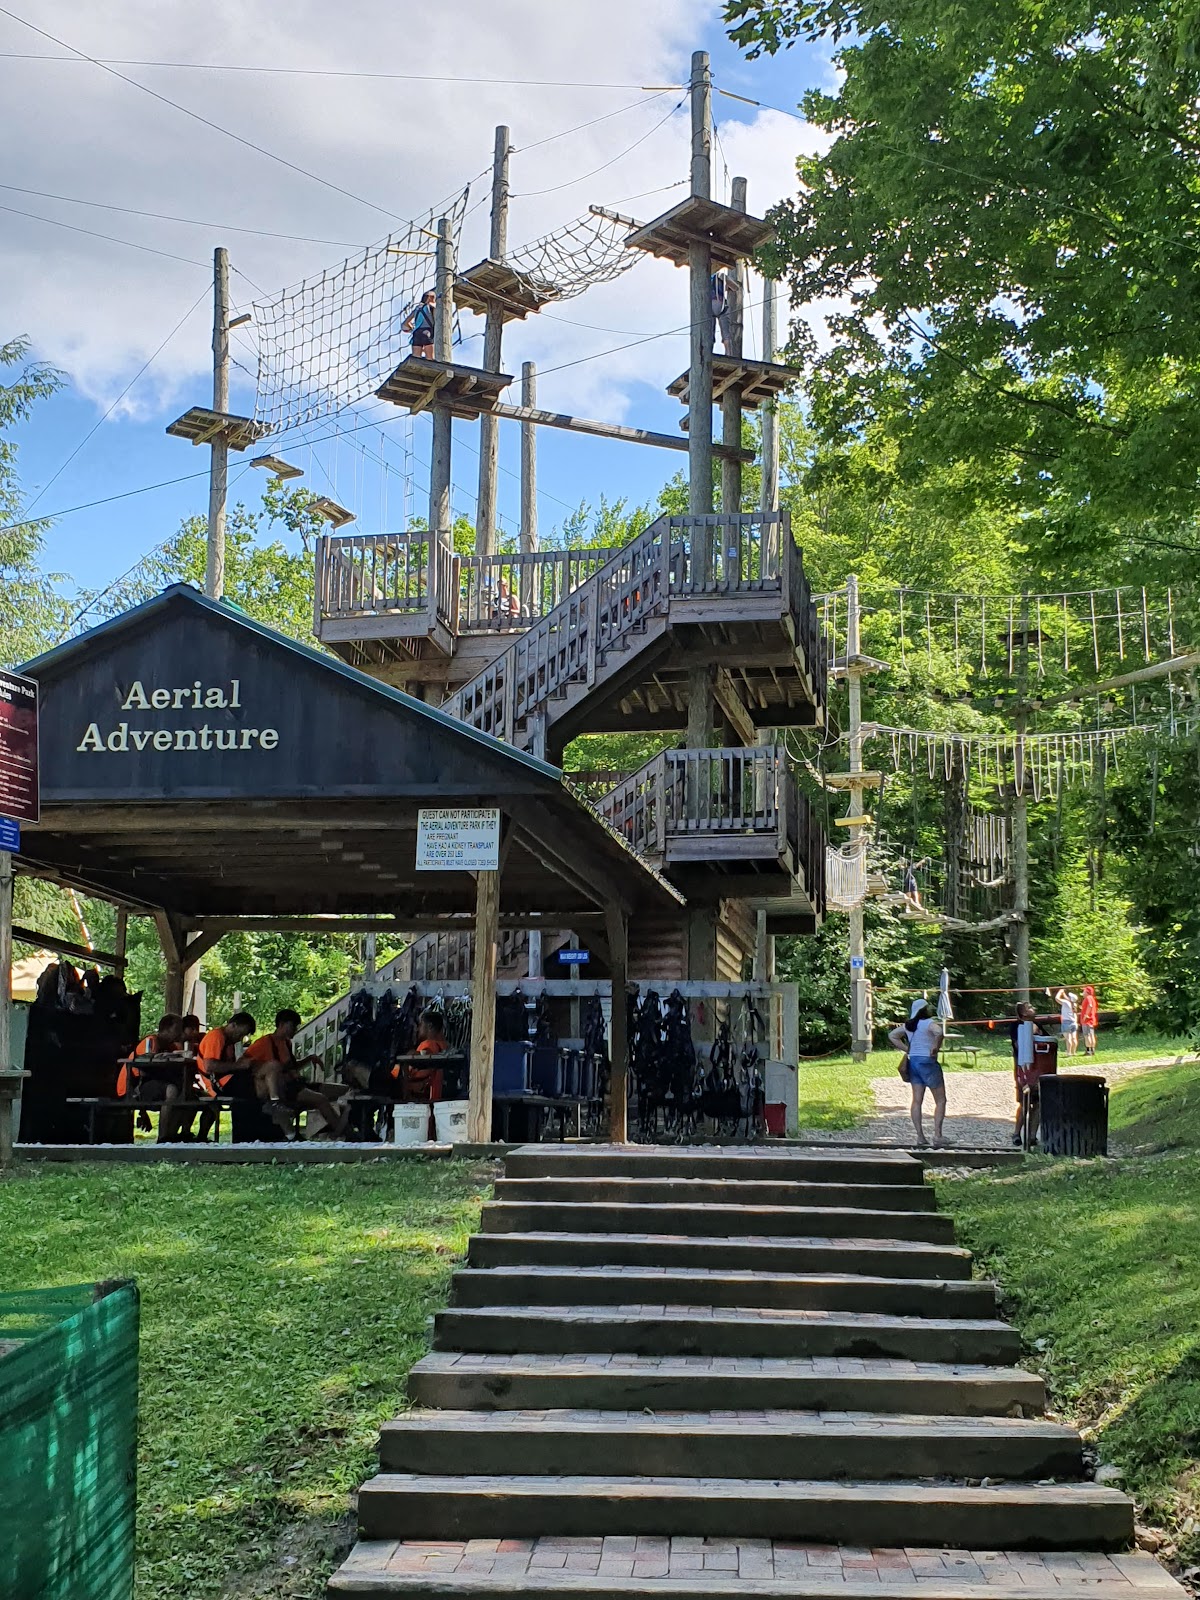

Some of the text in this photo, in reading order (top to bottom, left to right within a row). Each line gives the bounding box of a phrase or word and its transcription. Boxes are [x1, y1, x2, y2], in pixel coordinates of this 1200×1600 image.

[21, 685, 35, 699] Park
[121, 679, 242, 710] Aerial
[76, 722, 280, 752] Adventure
[422, 810, 497, 819] GUEST CAN NOT PARTICIPATE IN
[429, 821, 443, 830] AERIAL
[444, 821, 468, 830] ADVENTURE
[469, 821, 480, 829] PARK
[481, 821, 485, 829] IF
[486, 821, 497, 829] THEY
